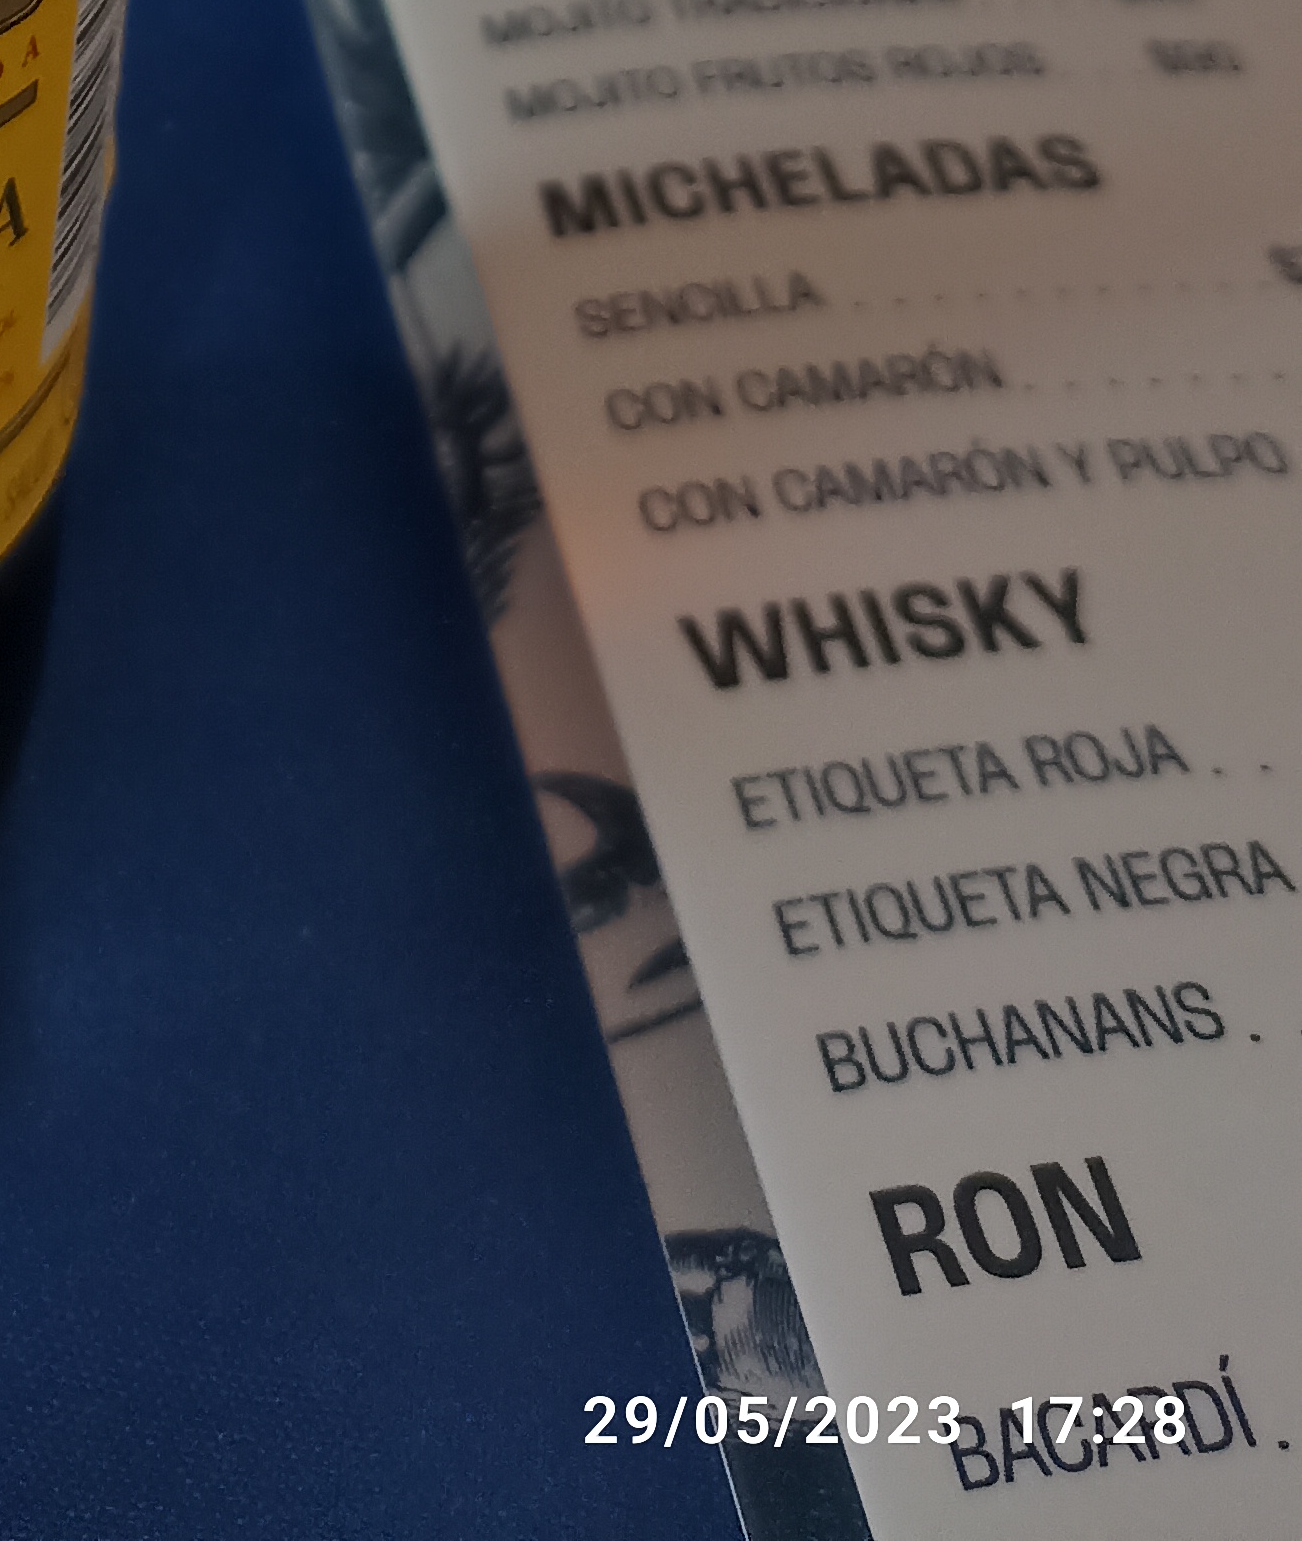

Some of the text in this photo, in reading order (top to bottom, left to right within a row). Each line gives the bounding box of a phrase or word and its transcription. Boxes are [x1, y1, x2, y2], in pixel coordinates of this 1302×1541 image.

[504, 39, 1048, 120] MOJITO FRUTOS ROJOS
[539, 134, 1102, 237] MICHELADAS
[573, 271, 826, 339] SENCILLA
[604, 340, 1004, 431] CON CAMARÓN
[637, 430, 1291, 533] CON CAMARÓN Y PULPO
[675, 565, 1091, 690] WHISKY
[730, 723, 1192, 832] ETIQUETA ROJA
[772, 839, 1298, 957] ETIQUETA NEGRA
[815, 980, 1226, 1094] BUCHANANS
[869, 1155, 1142, 1297] RON
[941, 1354, 1258, 1492] BACARDÍ
